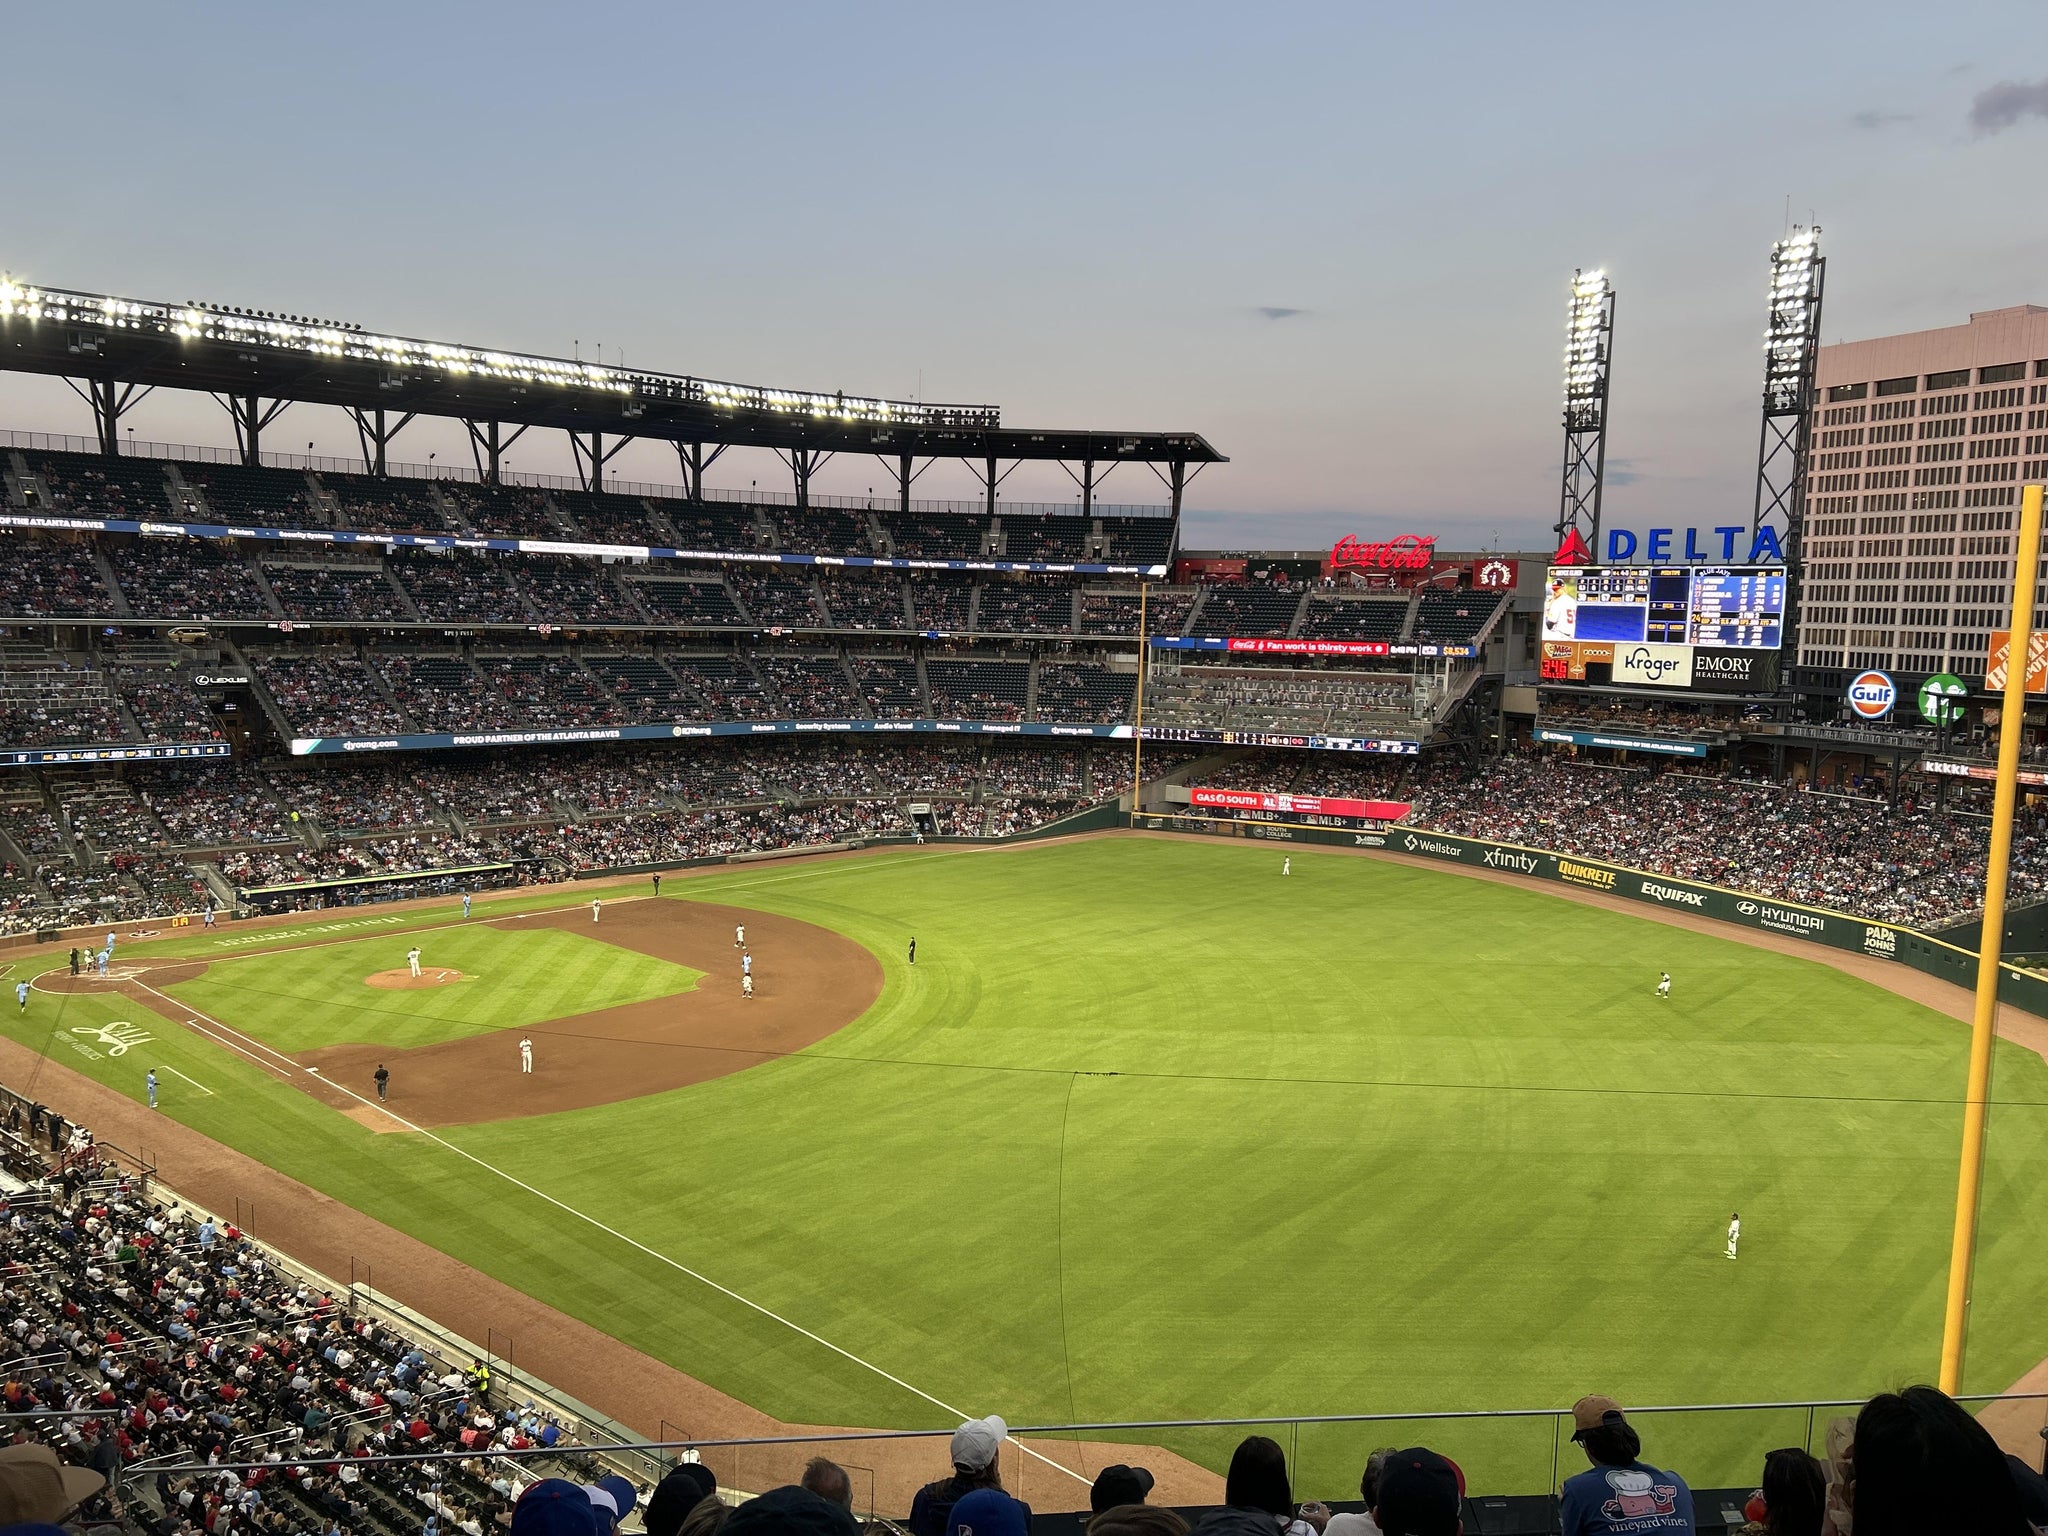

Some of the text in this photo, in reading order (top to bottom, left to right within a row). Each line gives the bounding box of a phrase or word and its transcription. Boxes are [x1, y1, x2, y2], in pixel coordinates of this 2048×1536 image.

[30, 518, 70, 528] ATLANTA
[70, 519, 105, 529] BRAVES
[278, 531, 334, 540] Security Systems
[1608, 525, 1782, 560] DELTA
[734, 552, 759, 560] ATLANTA
[1330, 533, 1440, 569] Coca-Cola
[1699, 568, 1731, 578] BLUE JAYS
[1691, 614, 1701, 623] 24
[279, 620, 293, 632] 41
[538, 624, 552, 634] 44
[1267, 641, 1283, 651] Fan
[1285, 642, 1307, 652] work
[1309, 643, 1316, 651] is
[1317, 642, 1347, 654] thirsty
[1349, 645, 1372, 653] work
[1542, 660, 1567, 673] 346
[1625, 647, 1680, 681] Kroger
[1695, 656, 1753, 673] EMORY
[1695, 671, 1750, 681] HEALTHCARE
[1852, 686, 1892, 702] Gulf
[796, 723, 851, 731] Security Systems
[453, 730, 620, 745] PROUD PARTNER OF THE ATLANTA BRAVES
[165, 749, 175, 757] 27
[1197, 793, 1257, 805] GAS SOUTH
[1252, 811, 1279, 821] MLB+
[1319, 815, 1348, 826] MLB+
[1419, 840, 1461, 857] Wellstar
[1483, 847, 1538, 874] xfinity
[1558, 860, 1616, 885] QUIKRETE
[1641, 881, 1703, 907] EQUIFAX
[1761, 905, 1824, 931] HYUNDAI
[1760, 918, 1810, 936] HyundaiUSA.com
[1866, 926, 1896, 943] PAPA
[1864, 937, 1896, 952] JOHNS
[1608, 1516, 1688, 1534] vineyard vines
